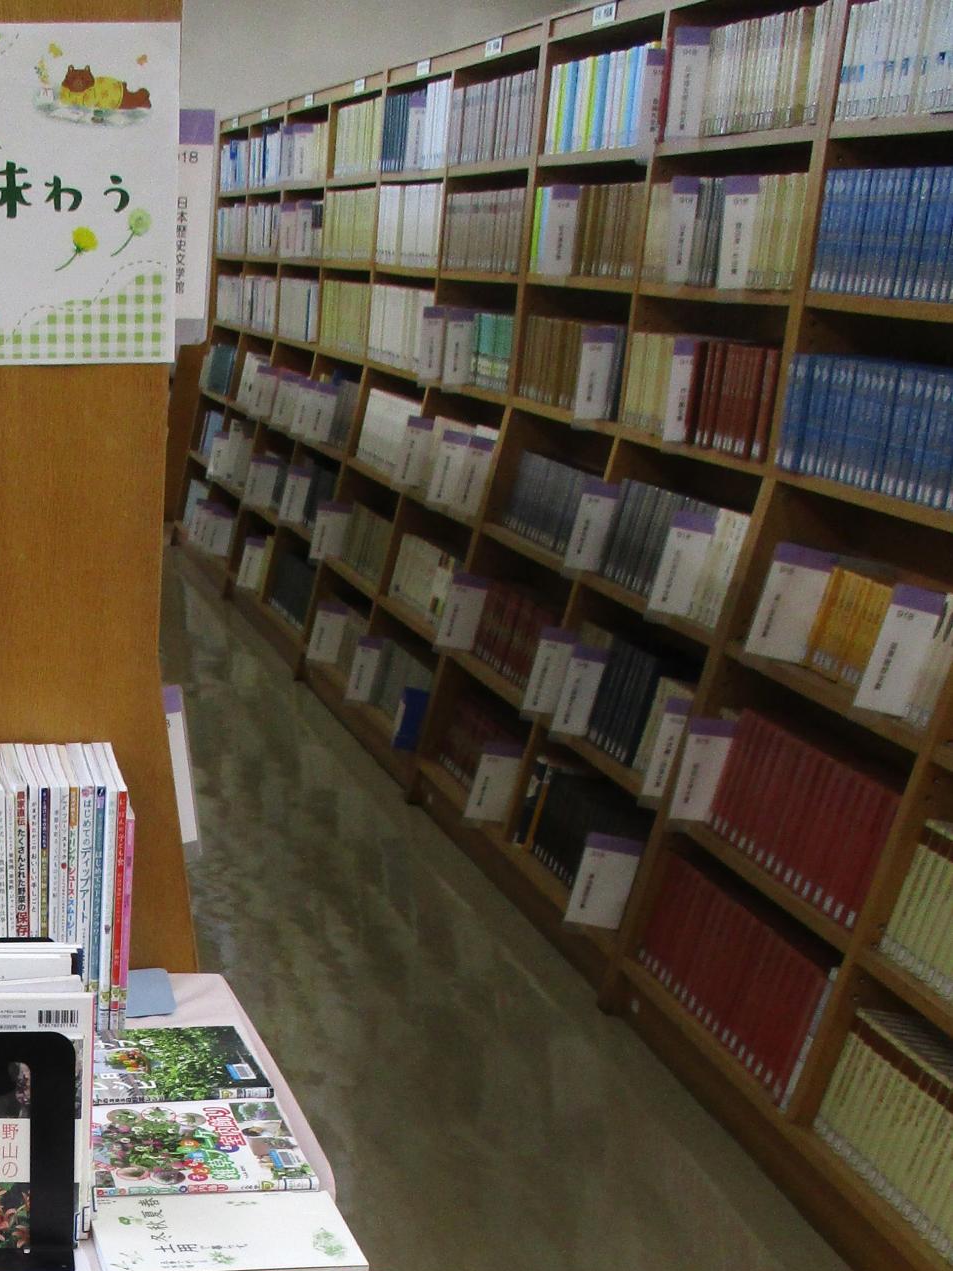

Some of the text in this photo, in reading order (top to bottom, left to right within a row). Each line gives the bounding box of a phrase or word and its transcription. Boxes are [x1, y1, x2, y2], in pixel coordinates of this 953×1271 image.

[178, 151, 199, 164] 18
[1, 1123, 19, 1178] 野山の
